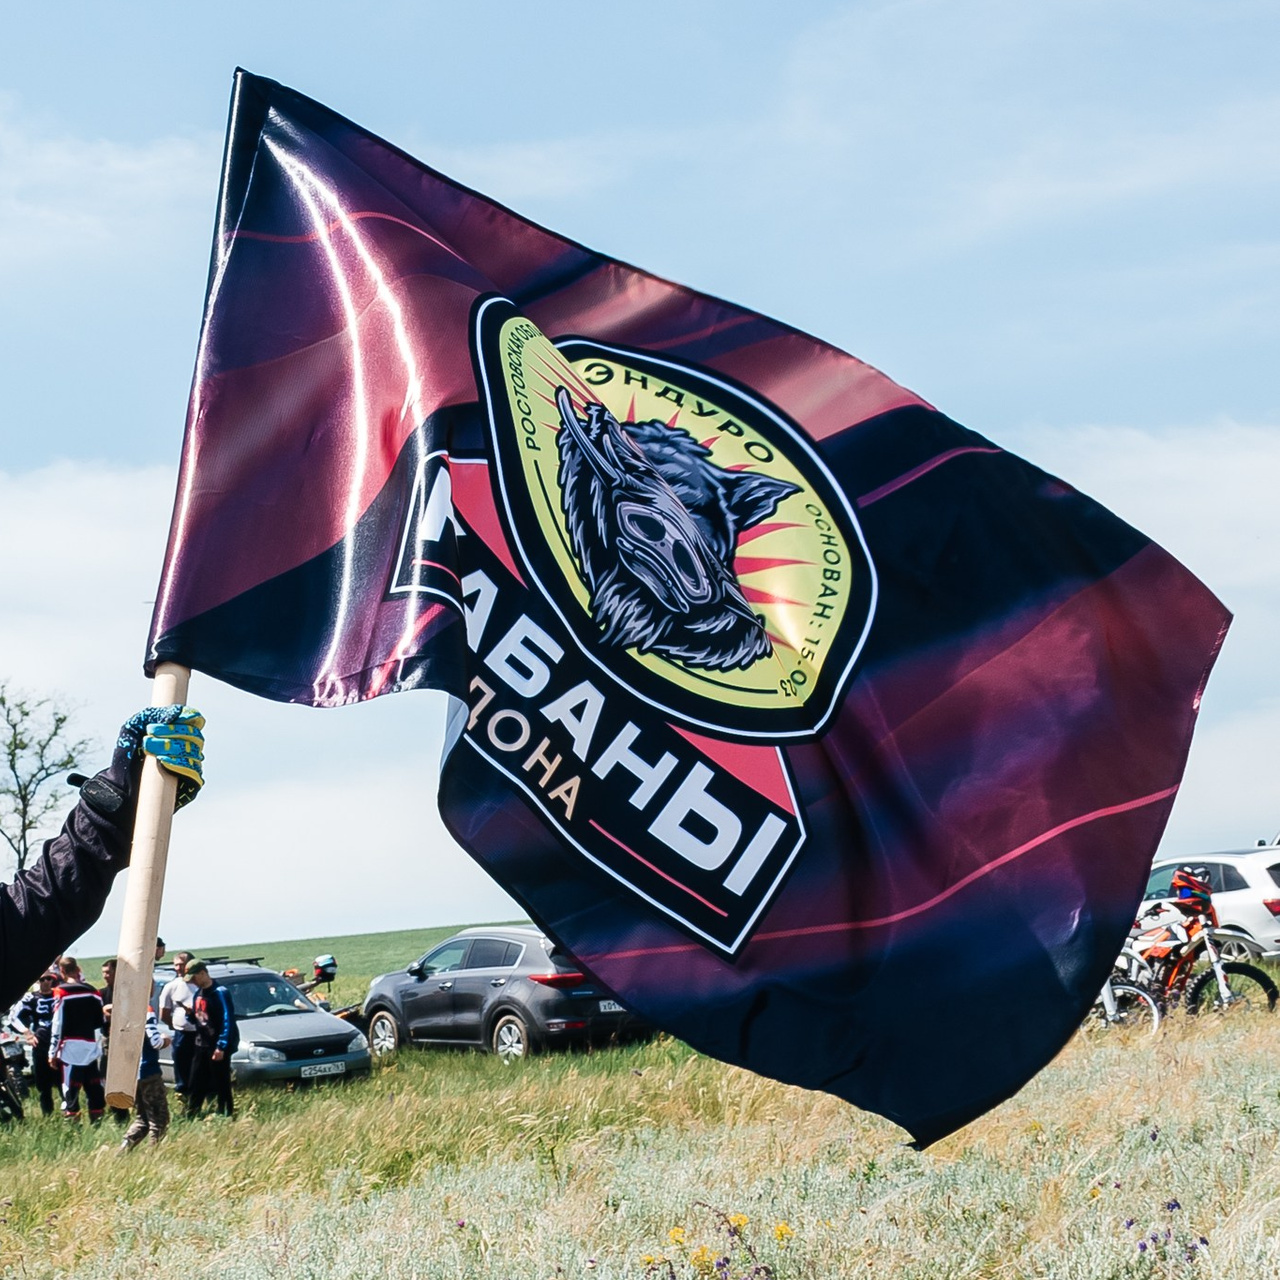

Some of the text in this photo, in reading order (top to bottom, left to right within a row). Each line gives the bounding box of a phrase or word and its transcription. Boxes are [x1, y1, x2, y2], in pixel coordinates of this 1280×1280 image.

[507, 331, 542, 452] РОСТОВСКАЯ
[584, 362, 774, 463] ЭНДУРО
[805, 504, 841, 629] ОСНОВАН:
